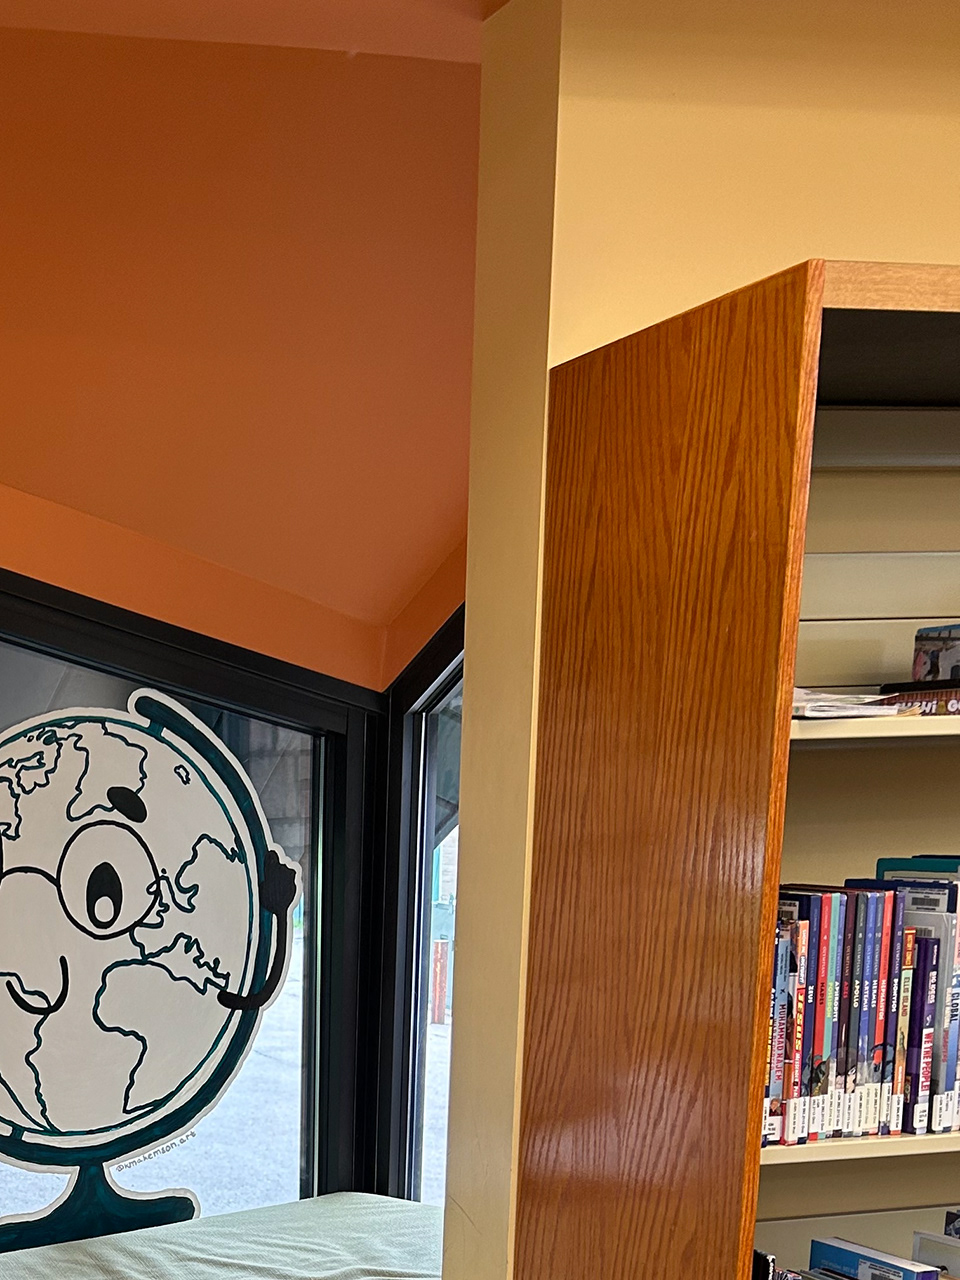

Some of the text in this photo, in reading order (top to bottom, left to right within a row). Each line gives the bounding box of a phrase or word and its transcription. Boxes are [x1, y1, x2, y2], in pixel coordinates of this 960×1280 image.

[807, 985, 815, 1003] ZEUS
[832, 981, 840, 1022] APHRODITE
[891, 978, 899, 1012] DIONYSOS
[901, 996, 909, 1017] ISLAND
[950, 993, 959, 1024] GLOBAL
[776, 1004, 786, 1051] MUHAMMAD
[795, 992, 803, 1051] JESUS
[923, 1045, 933, 1060] THE
[924, 1033, 933, 1044] WE
